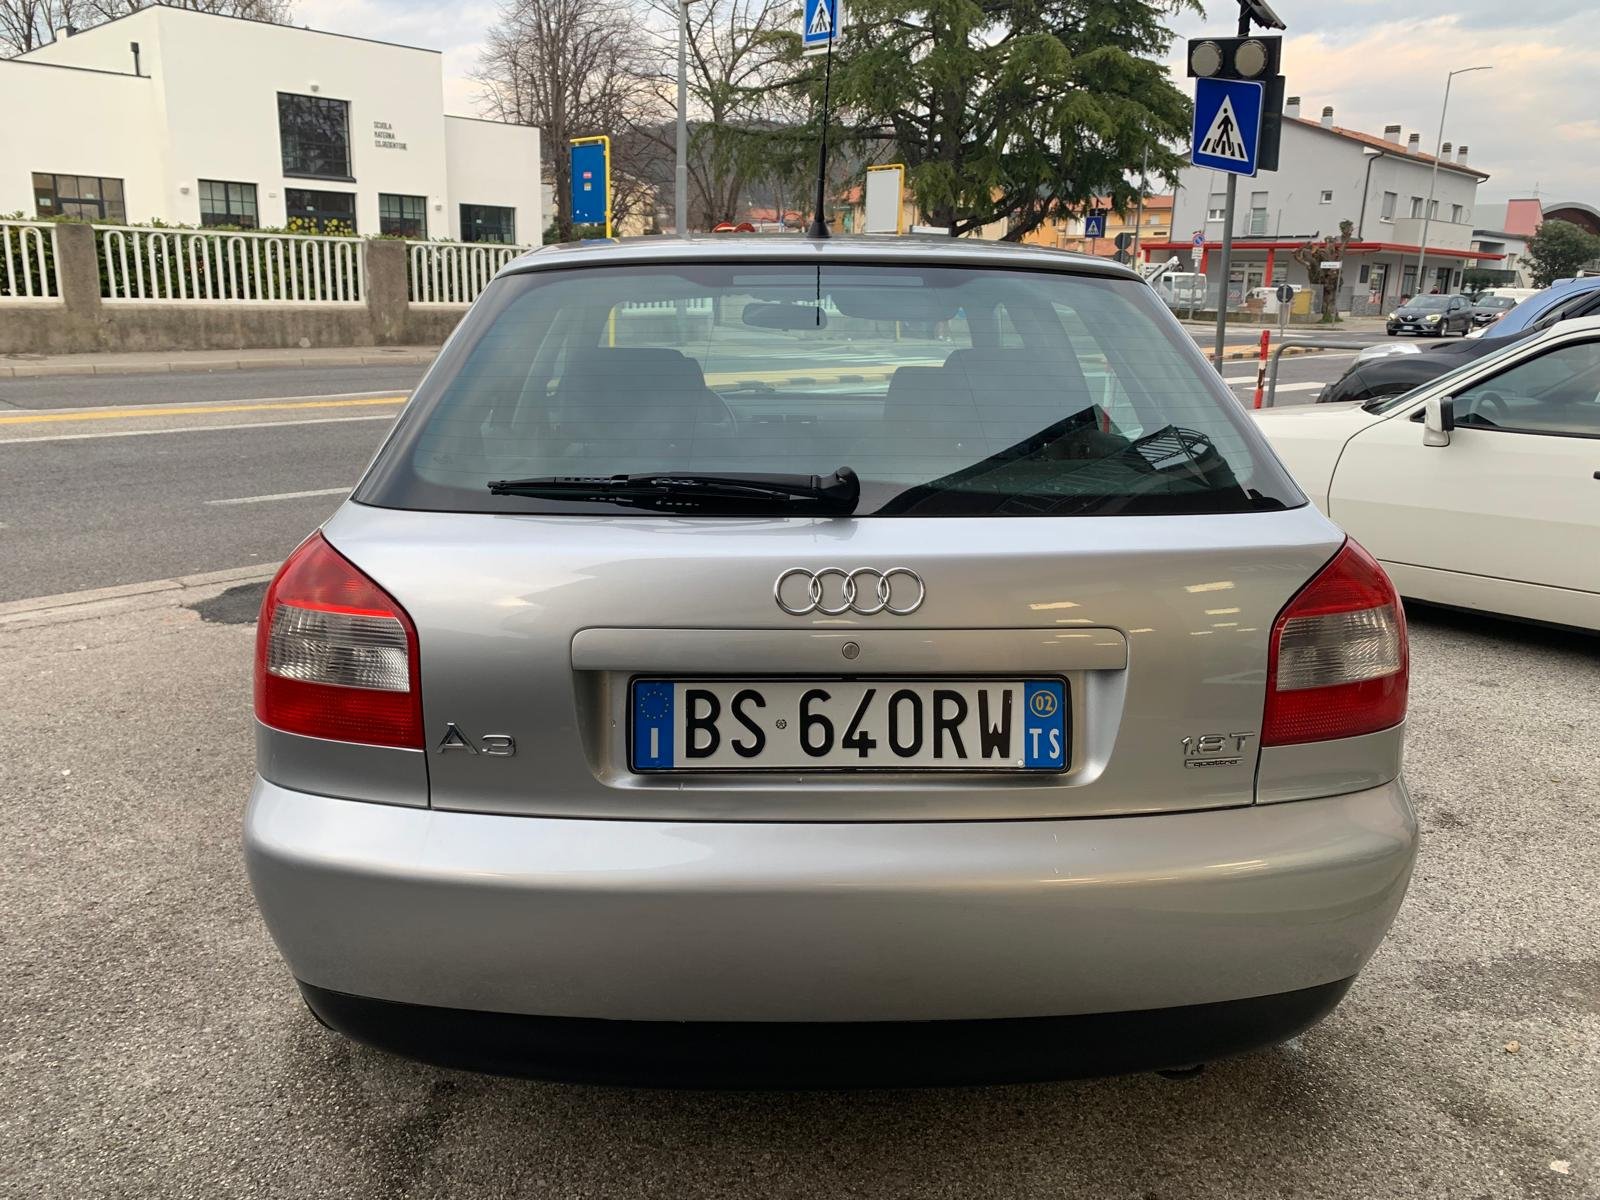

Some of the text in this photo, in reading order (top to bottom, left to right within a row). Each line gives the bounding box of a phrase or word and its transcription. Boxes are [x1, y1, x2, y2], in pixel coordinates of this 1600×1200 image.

[373, 121, 392, 130] SCUOLA
[374, 131, 395, 139] MATERNA
[1035, 695, 1053, 712] 02
[685, 688, 1013, 759] BS 640RW
[436, 722, 517, 757] A3
[650, 727, 659, 759] I
[1029, 728, 1060, 759] TS
[1193, 759, 1238, 768] quattro
